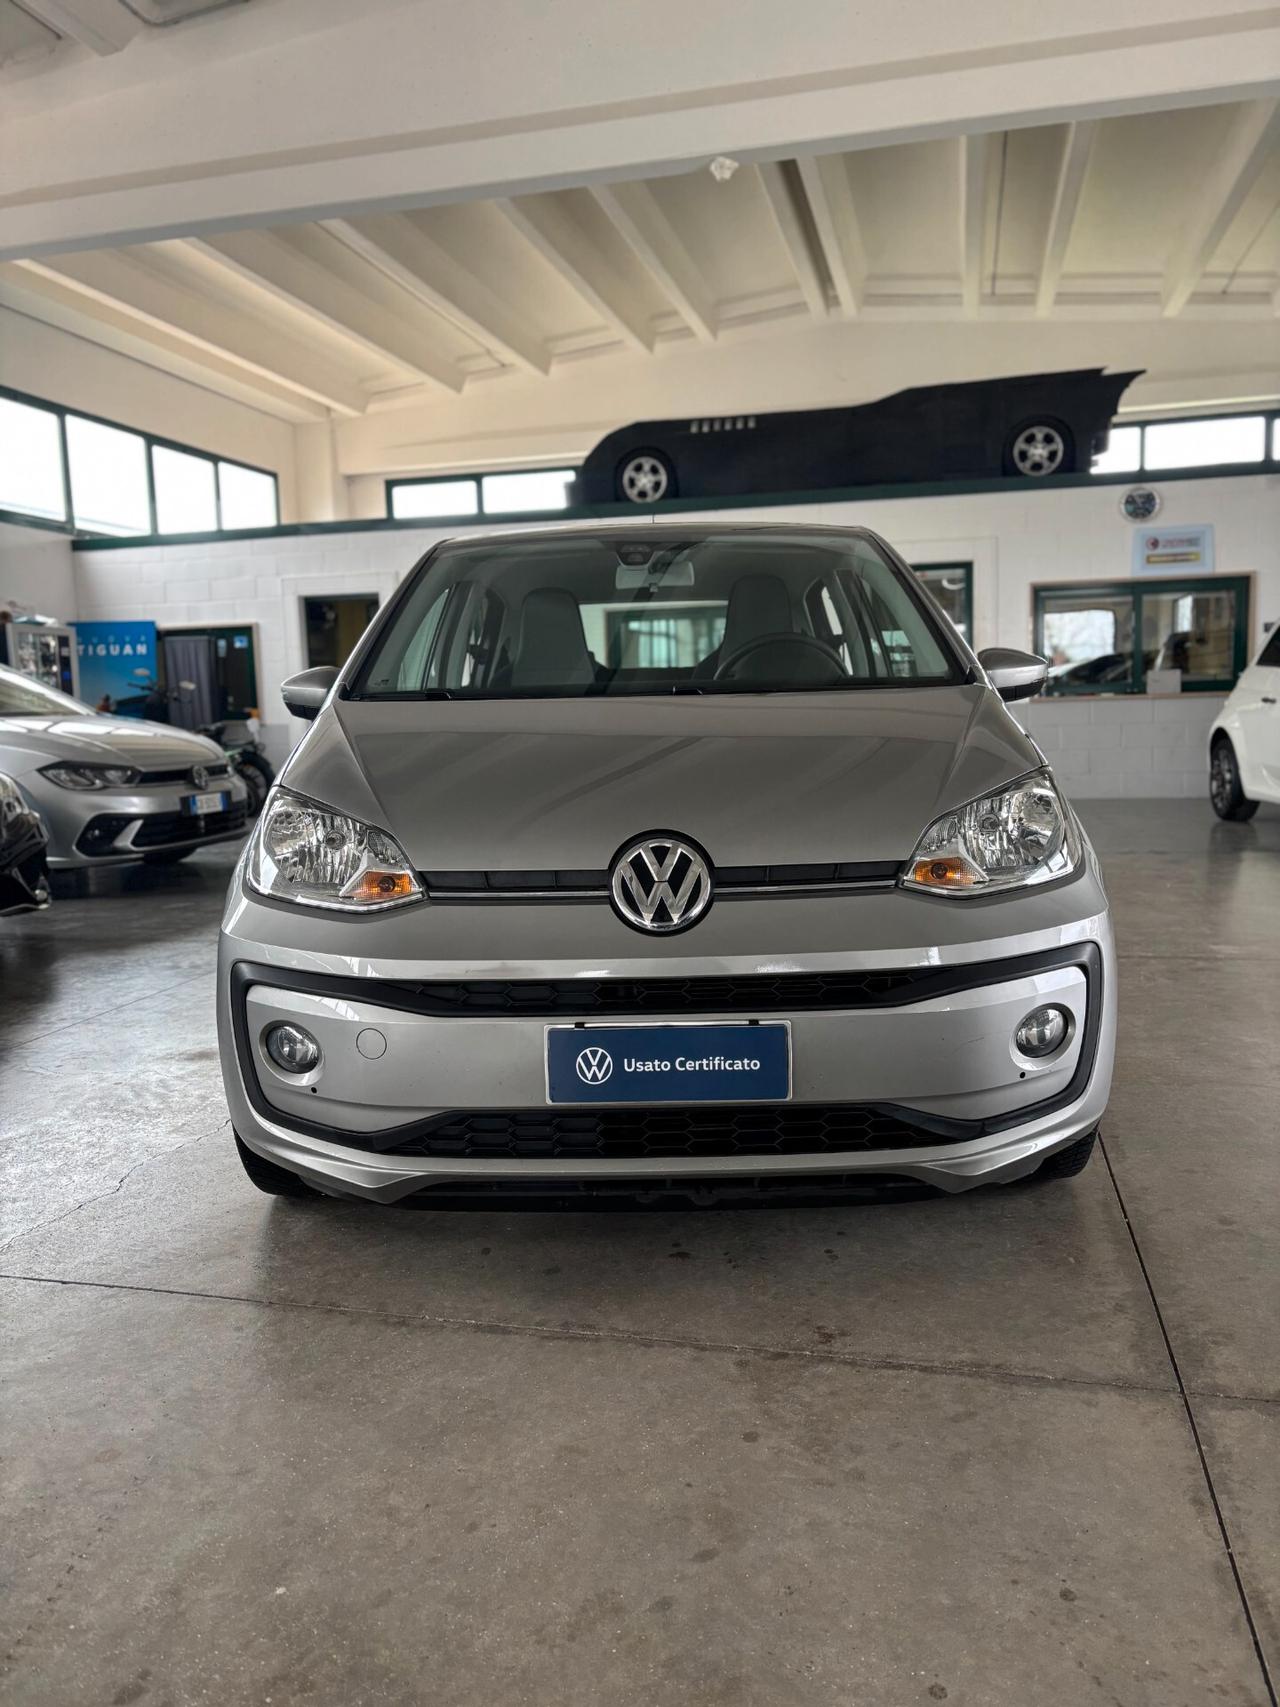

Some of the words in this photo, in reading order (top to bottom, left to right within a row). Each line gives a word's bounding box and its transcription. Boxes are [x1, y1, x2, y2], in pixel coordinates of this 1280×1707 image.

[78, 643, 147, 656] TIGUAN
[623, 1057, 671, 1072] Usato
[675, 1056, 761, 1071] Certificato
